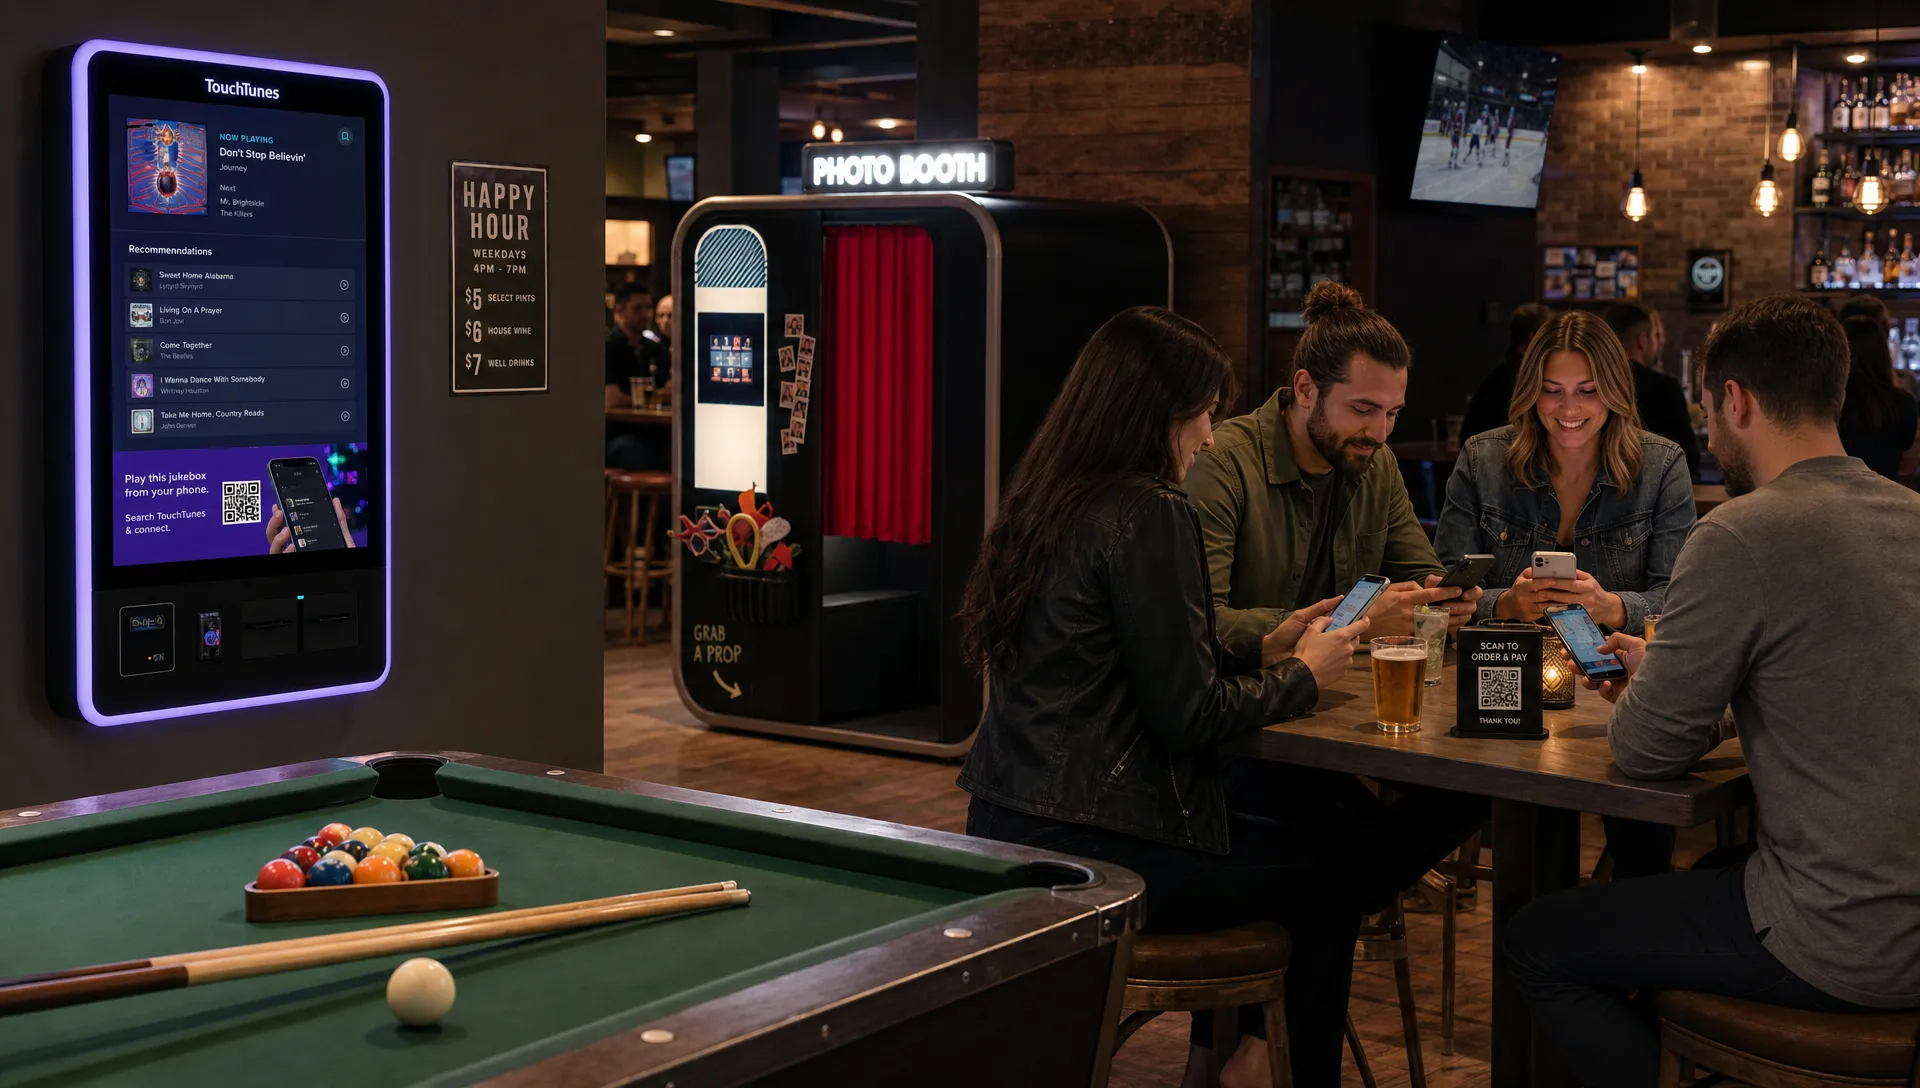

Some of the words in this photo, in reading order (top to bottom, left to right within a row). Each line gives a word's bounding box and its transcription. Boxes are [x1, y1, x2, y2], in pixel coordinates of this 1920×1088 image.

[205, 79, 279, 99] TouchTunes
[241, 135, 274, 144] PLAYING
[220, 148, 244, 158] Don't
[246, 149, 266, 161] Stop
[269, 151, 306, 162] Believin'
[220, 164, 247, 173] Journey
[813, 155, 894, 186] PHOTO
[900, 153, 986, 184] BOOTH
[220, 184, 236, 192] Next
[463, 181, 535, 210] HAPPY
[232, 199, 264, 207] Brightside
[234, 210, 253, 218] Killers
[471, 212, 529, 240] HOUR
[473, 248, 526, 260] WEEKDAYS
[474, 264, 494, 274] 4PM
[506, 264, 526, 274] 7PM
[159, 271, 181, 279] Sweet
[205, 272, 234, 280] Alabama
[465, 287, 482, 310] $5
[488, 294, 514, 302] SELECT
[515, 294, 536, 302] PINTS
[160, 307, 180, 315] Living
[201, 307, 223, 315] Prayer
[465, 319, 482, 343] $6
[488, 326, 512, 335] HOUSE
[513, 326, 532, 335] WINE
[183, 342, 212, 350] Together
[465, 352, 482, 376] $7
[488, 359, 507, 368] WELL
[509, 359, 535, 367] DRINKS
[190, 376, 212, 384] Dance
[230, 375, 265, 384] Somebody
[216, 410, 242, 418] Country
[244, 409, 264, 417] Roads
[125, 474, 146, 485] Play
[148, 473, 166, 482] this
[168, 472, 206, 484] jukebox
[125, 488, 148, 497] from
[152, 488, 174, 498] your
[176, 486, 209, 497] phone.
[125, 513, 154, 522] Search
[157, 510, 206, 520] TouchTunes
[125, 526, 132, 534] &
[134, 525, 170, 534] connect.
[694, 624, 726, 641] GRAB
[1480, 642, 1504, 650] SCAN
[1507, 642, 1518, 650] TO
[693, 645, 702, 662] A
[707, 645, 742, 663] PROP
[1471, 653, 1501, 661] ORDER
[1503, 653, 1509, 661] &
[1511, 653, 1528, 661] PAY
